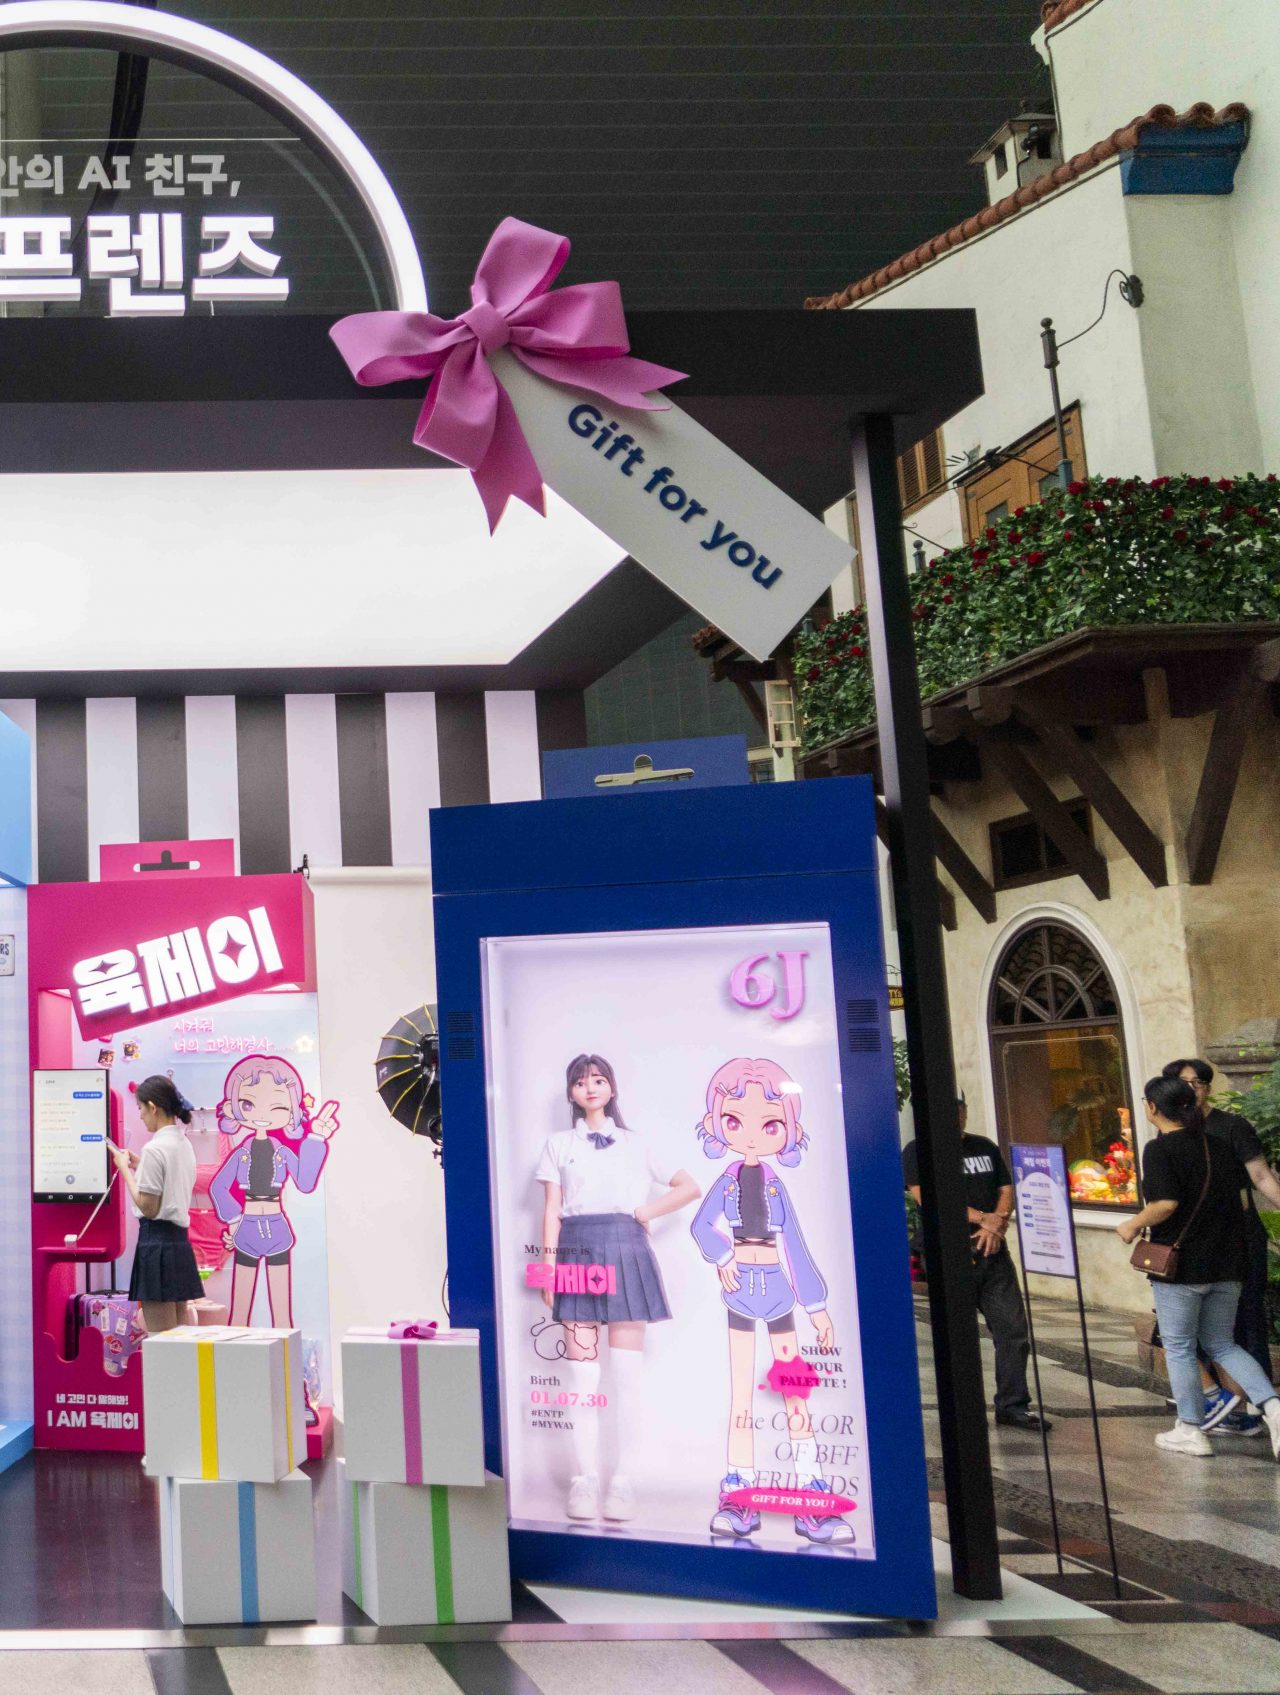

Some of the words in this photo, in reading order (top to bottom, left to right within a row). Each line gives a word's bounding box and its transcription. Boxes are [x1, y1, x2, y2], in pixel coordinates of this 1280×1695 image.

[78, 155, 131, 190] AI
[144, 154, 241, 198] 친구,
[568, 403, 645, 477] Gift
[643, 466, 708, 523] for
[699, 520, 783, 590] you
[73, 906, 284, 1017] 육제이
[729, 951, 809, 1021] 6J
[174, 1038, 199, 1053] 너의
[524, 1244, 541, 1256] My
[545, 1246, 577, 1255] name
[580, 1245, 591, 1256] is
[526, 1263, 616, 1297] 육제이
[801, 1345, 842, 1357] SHOW
[806, 1361, 843, 1373] YOUR
[530, 1375, 561, 1386] Birth
[780, 1375, 840, 1388] PALETTE
[67, 1393, 86, 1404] 고민
[530, 1390, 608, 1408] 01.07.30
[47, 1410, 53, 1427] I
[56, 1410, 87, 1428] AM
[90, 1411, 139, 1430] 육제이
[531, 1409, 564, 1418] #ENTP
[531, 1420, 575, 1430] #MYWAY
[736, 1409, 765, 1430] the
[771, 1411, 854, 1435] COLOR
[775, 1441, 809, 1462] OF
[815, 1443, 859, 1466] BFF
[756, 1470, 860, 1497] FRIENDS
[751, 1494, 779, 1504] GIFT
[780, 1496, 803, 1506] FOR
[805, 1498, 829, 1508] YOU
